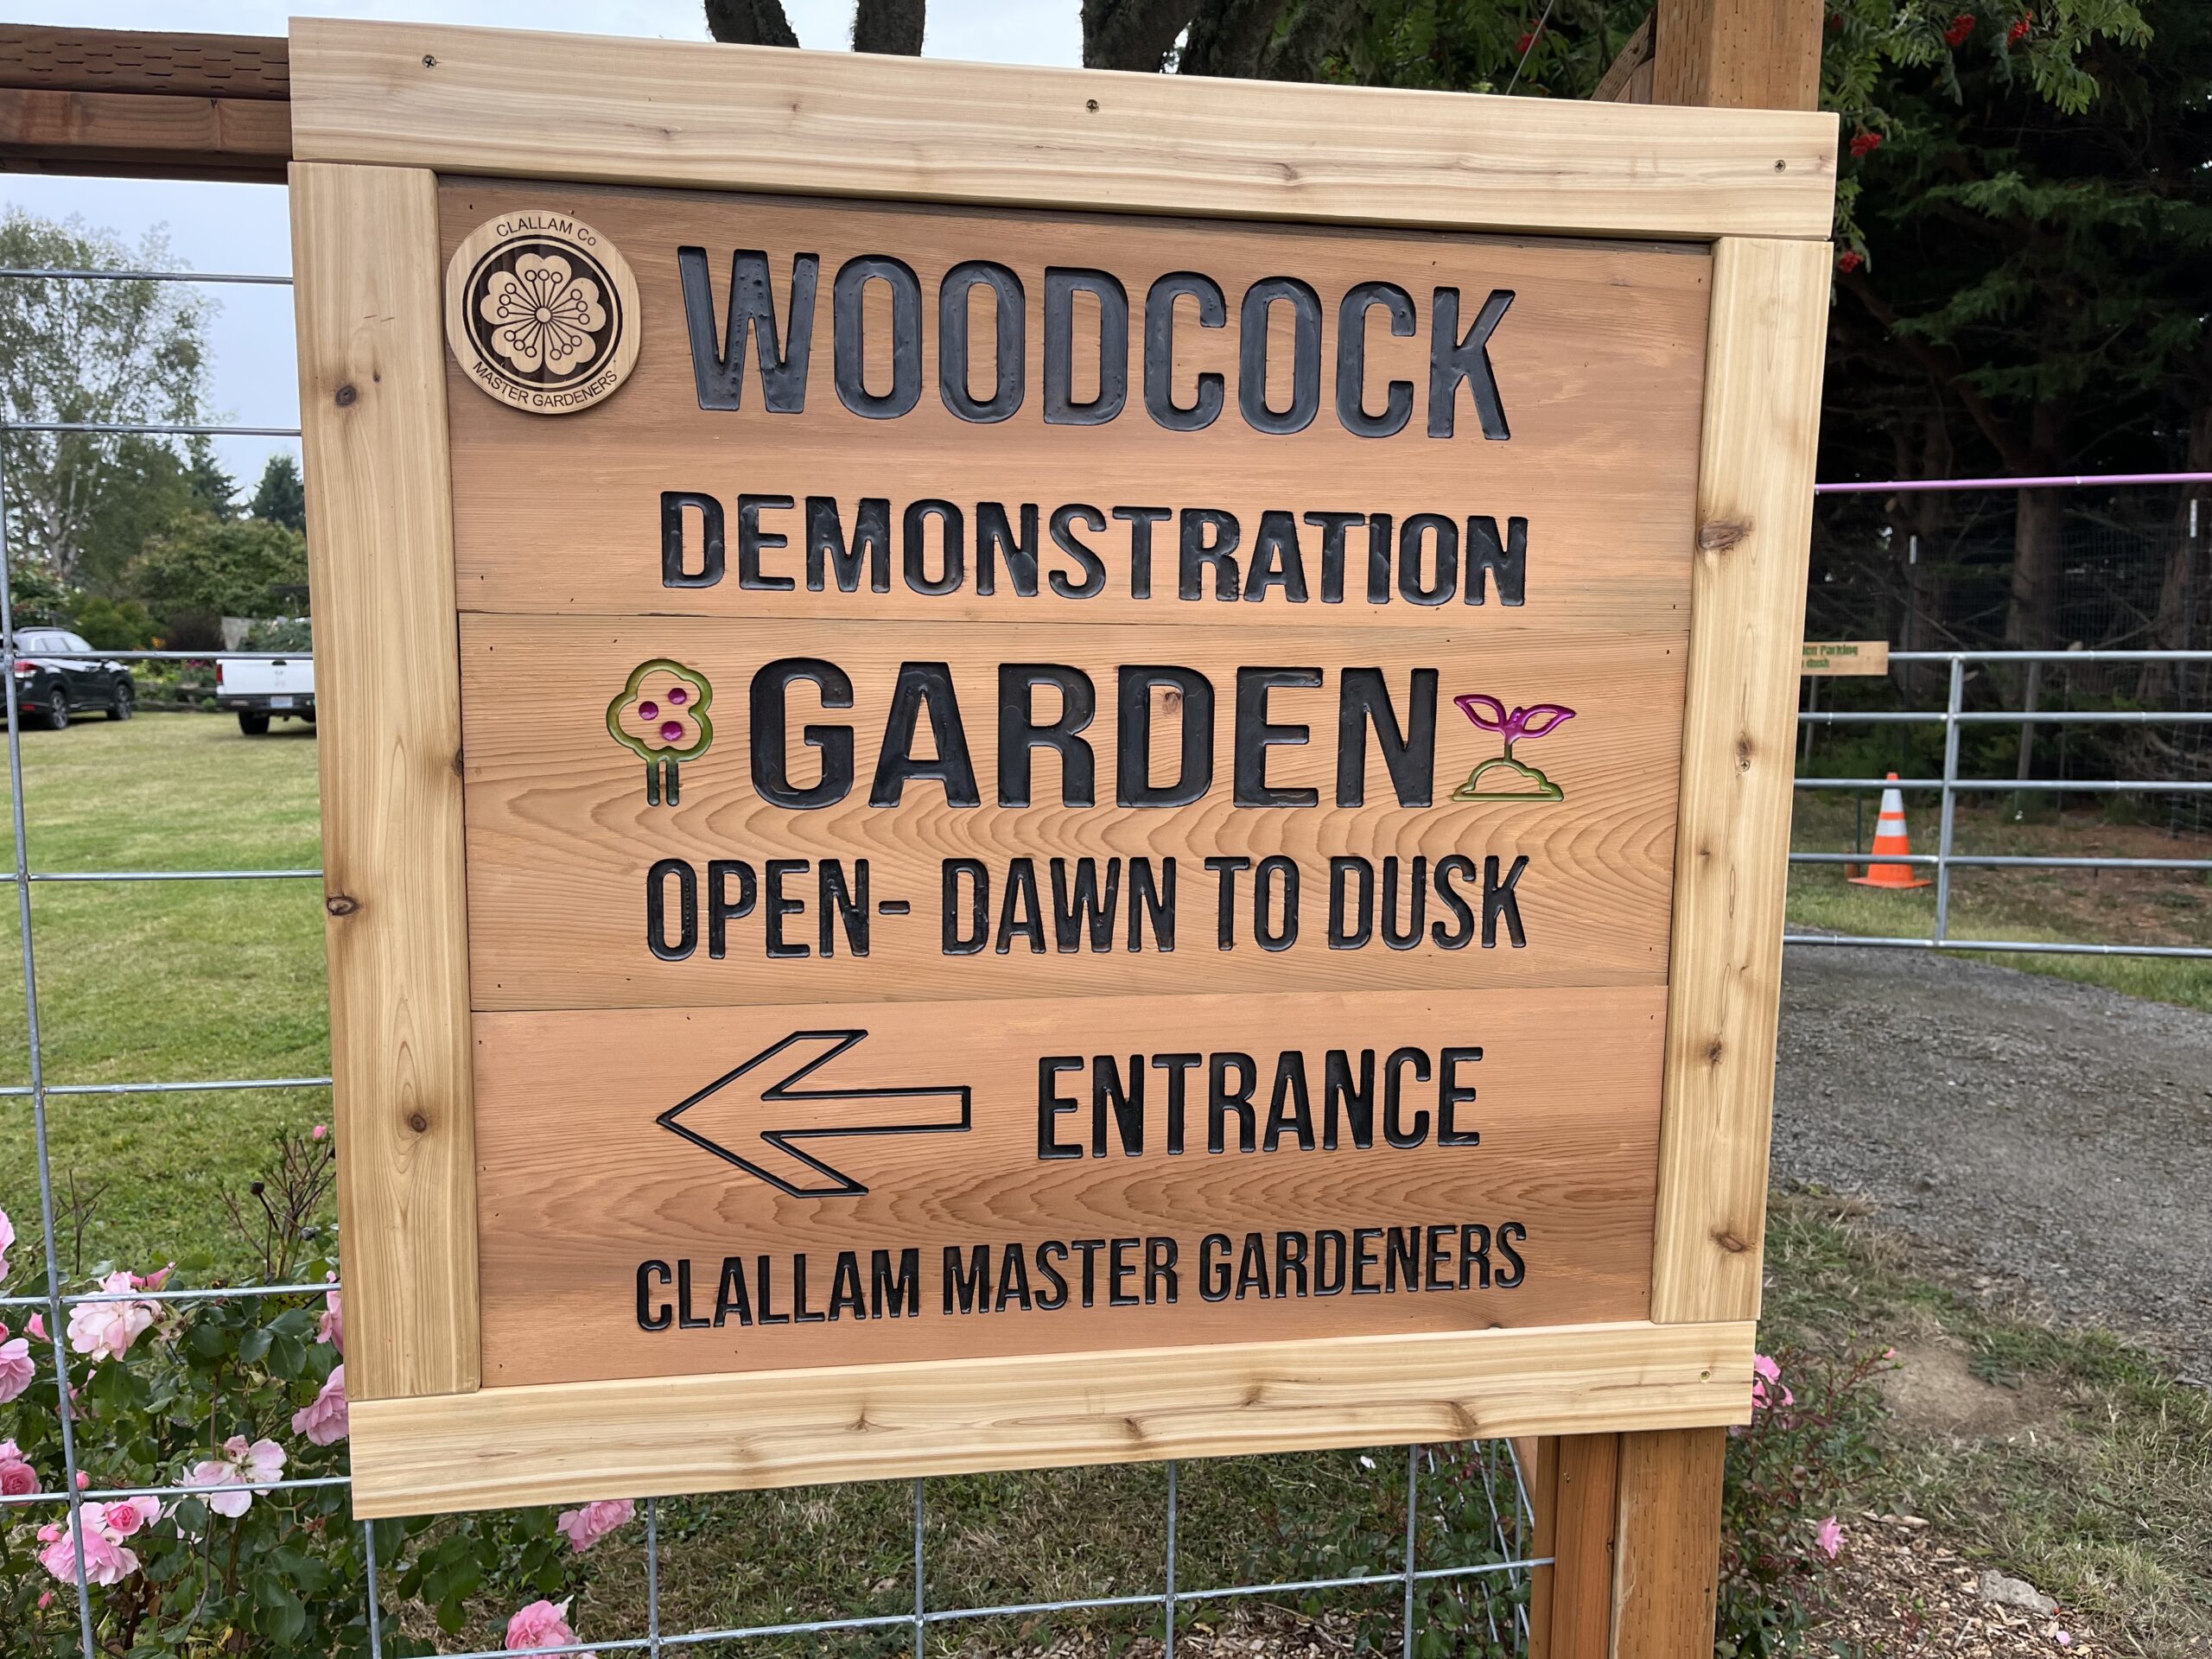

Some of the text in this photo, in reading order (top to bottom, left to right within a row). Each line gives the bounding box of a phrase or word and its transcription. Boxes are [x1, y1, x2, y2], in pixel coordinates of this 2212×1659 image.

[496, 217, 597, 246] CLALLAM Co
[473, 361, 618, 407] MASTER GARDENERS
[677, 245, 1517, 442] WOODCOCK
[660, 491, 1529, 607] DEMONSTRATION
[1806, 658, 1830, 668] dusk
[1821, 645, 1859, 656] Parking
[749, 657, 1440, 810] GARDEN
[646, 854, 1529, 963] OPEN- DAWN TO DUSK
[1037, 1046, 1484, 1160] ENTRANCE
[636, 1221, 1529, 1332] CLALLAM MASTER GARDENERS
